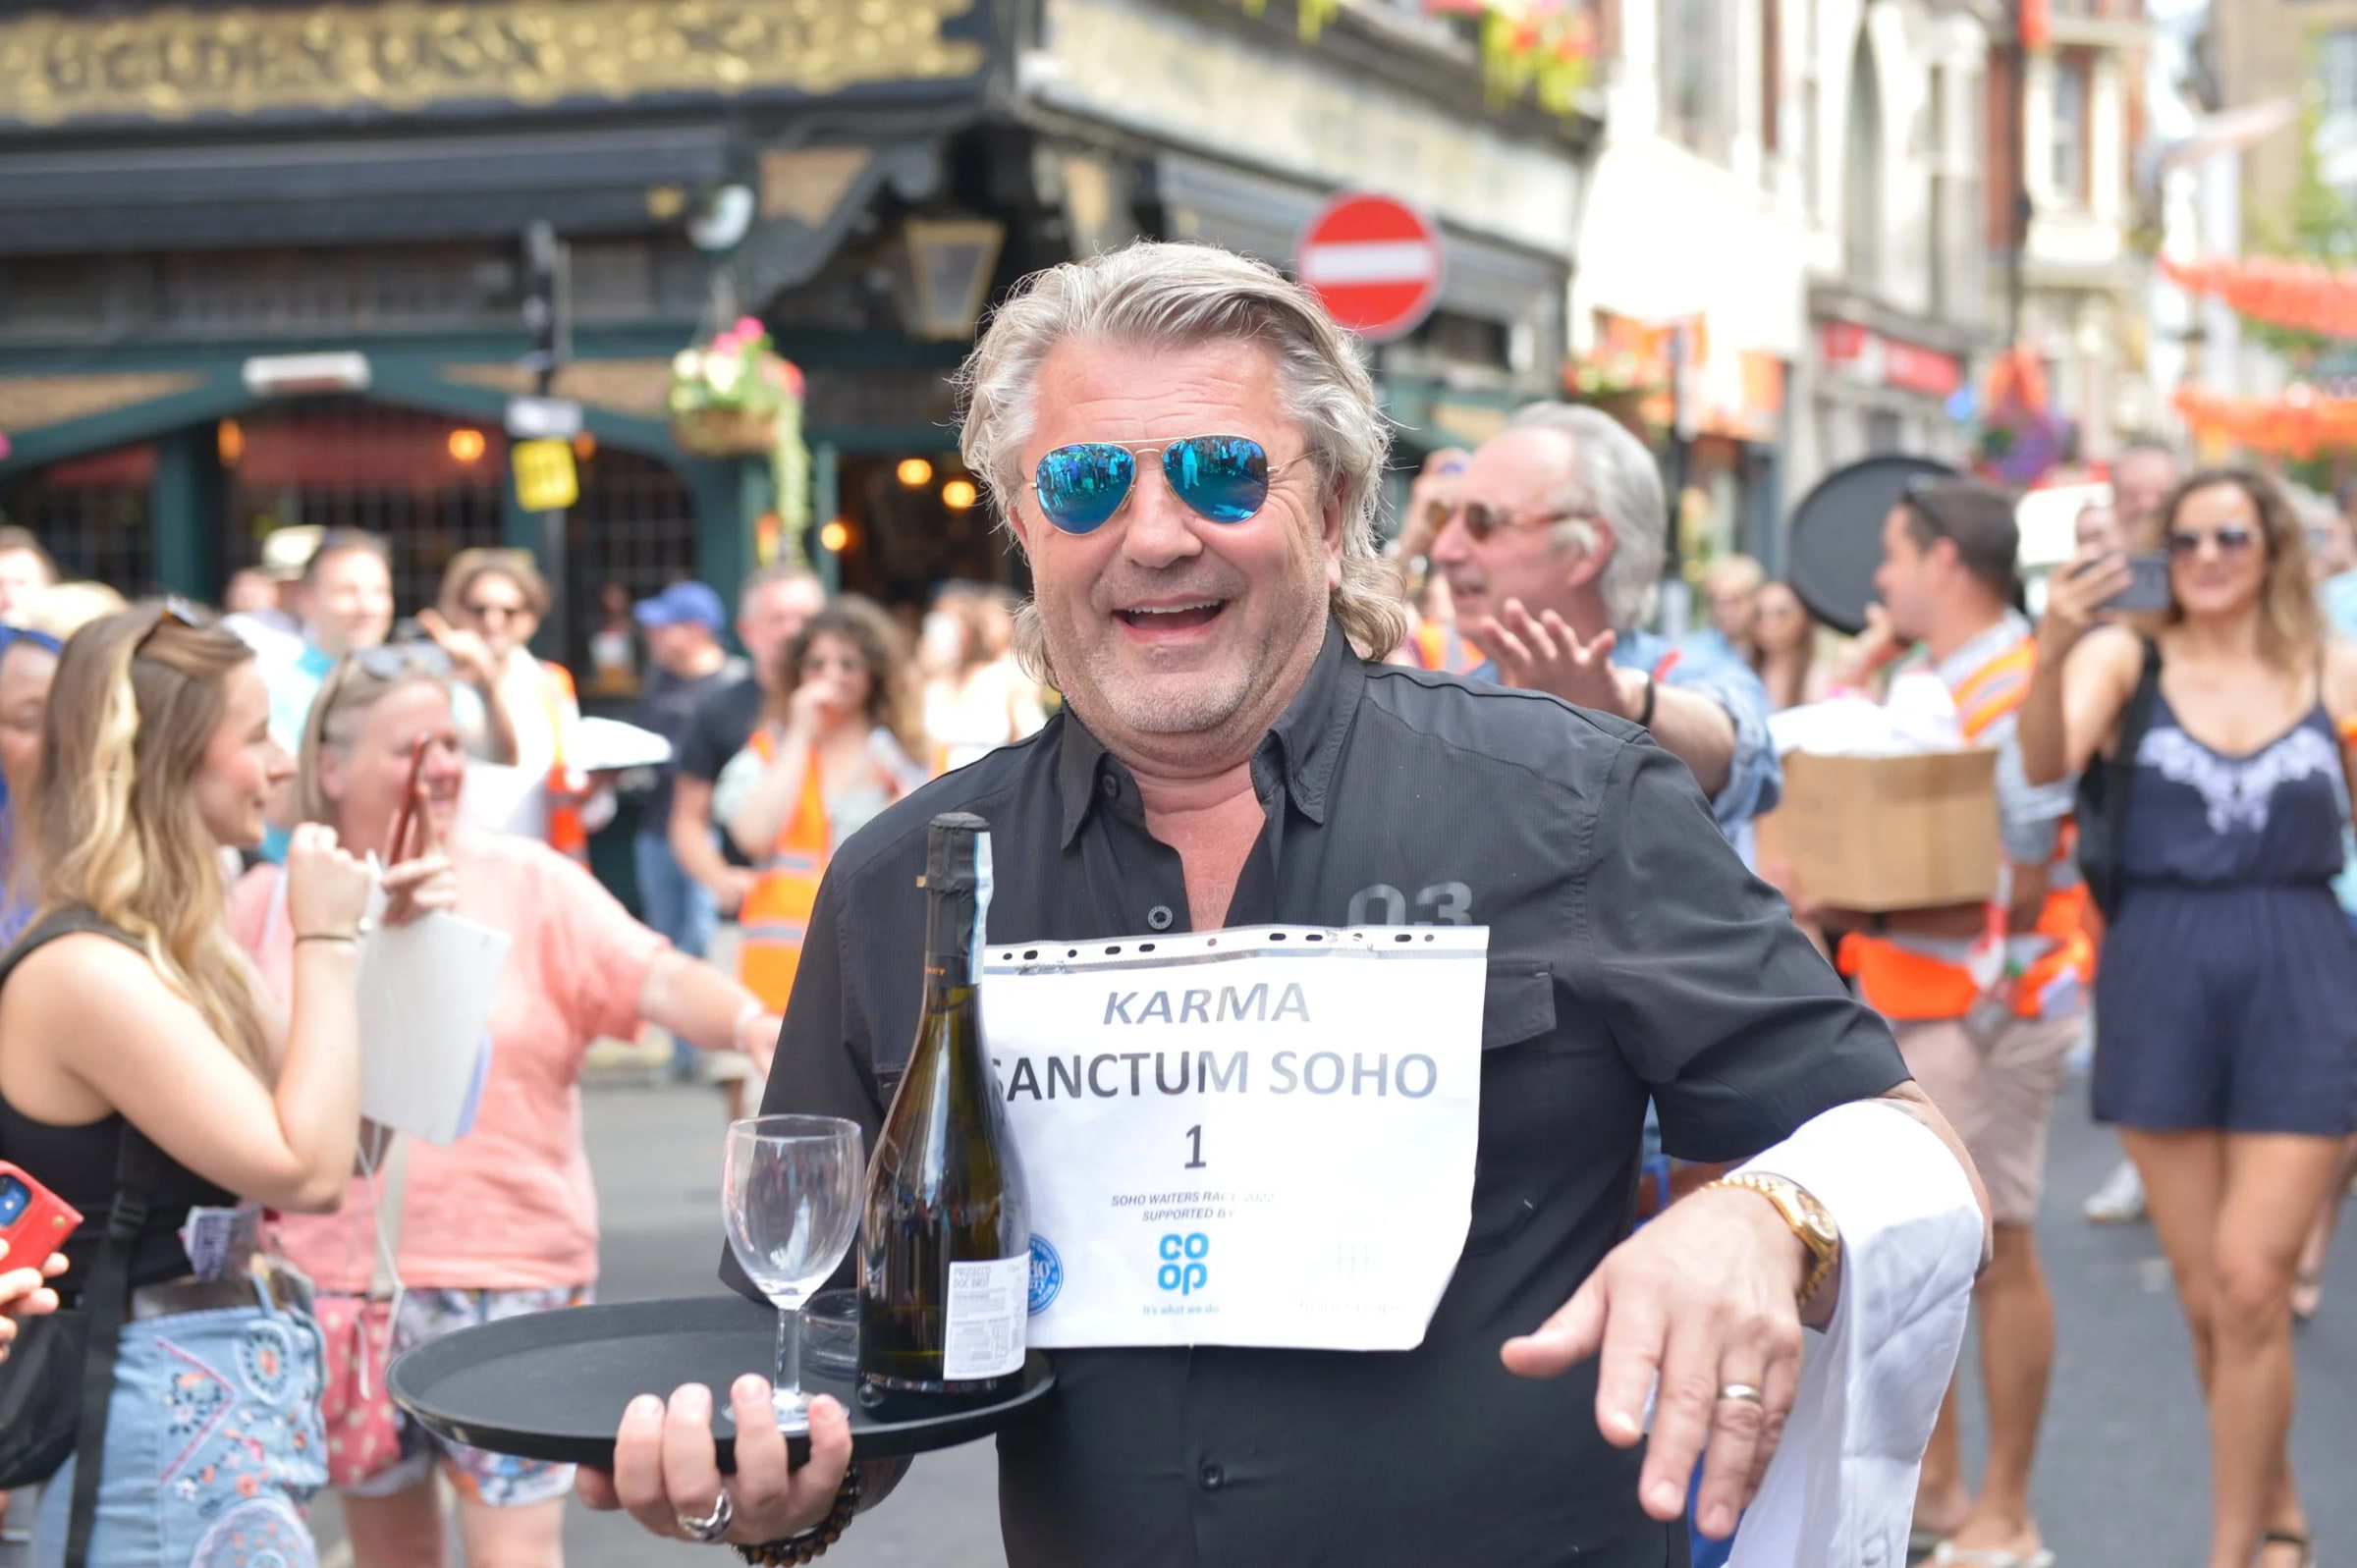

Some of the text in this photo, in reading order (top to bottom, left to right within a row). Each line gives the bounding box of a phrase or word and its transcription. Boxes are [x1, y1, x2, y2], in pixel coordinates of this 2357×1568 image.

[1104, 983, 1310, 1025] KARMA
[1269, 1051, 1438, 1099] SOHO
[1184, 1124, 1207, 1169] 1
[1112, 1195, 1146, 1207] SOHO
[1150, 1192, 1199, 1205] WAITERS
[1142, 1208, 1214, 1221] SUPPORTED
